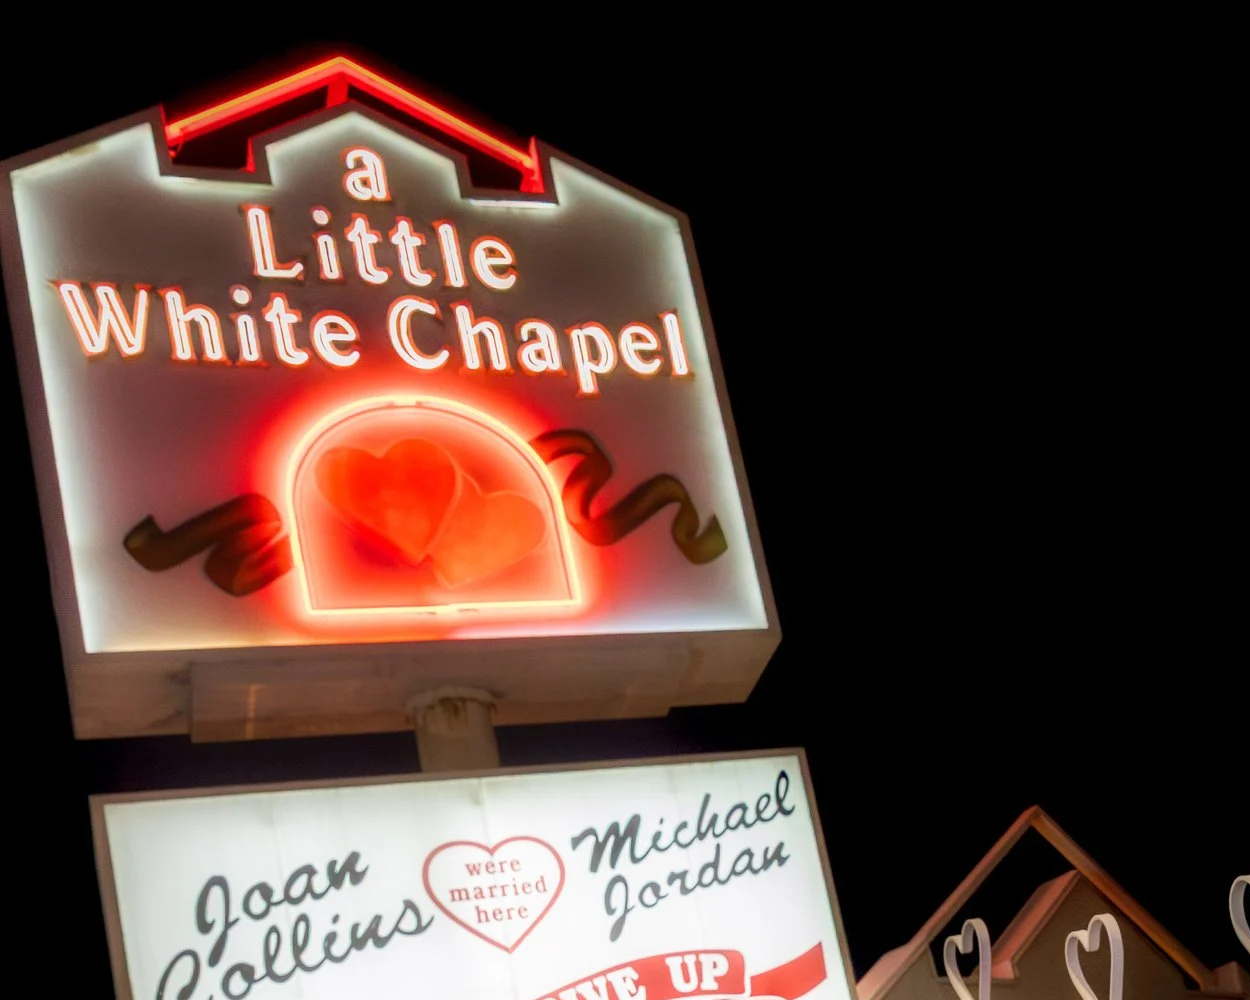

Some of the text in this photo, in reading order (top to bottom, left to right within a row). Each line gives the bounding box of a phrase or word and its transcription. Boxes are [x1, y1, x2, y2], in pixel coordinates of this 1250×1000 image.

[344, 145, 390, 204] a
[240, 203, 519, 292] Little
[50, 278, 694, 395] White Chapel
[571, 770, 795, 873] Michael
[448, 876, 548, 903] married
[465, 858, 522, 877] were
[603, 840, 790, 942] Jordan
[195, 850, 370, 968] Joan
[474, 904, 529, 924] here
[664, 952, 730, 994] UP
